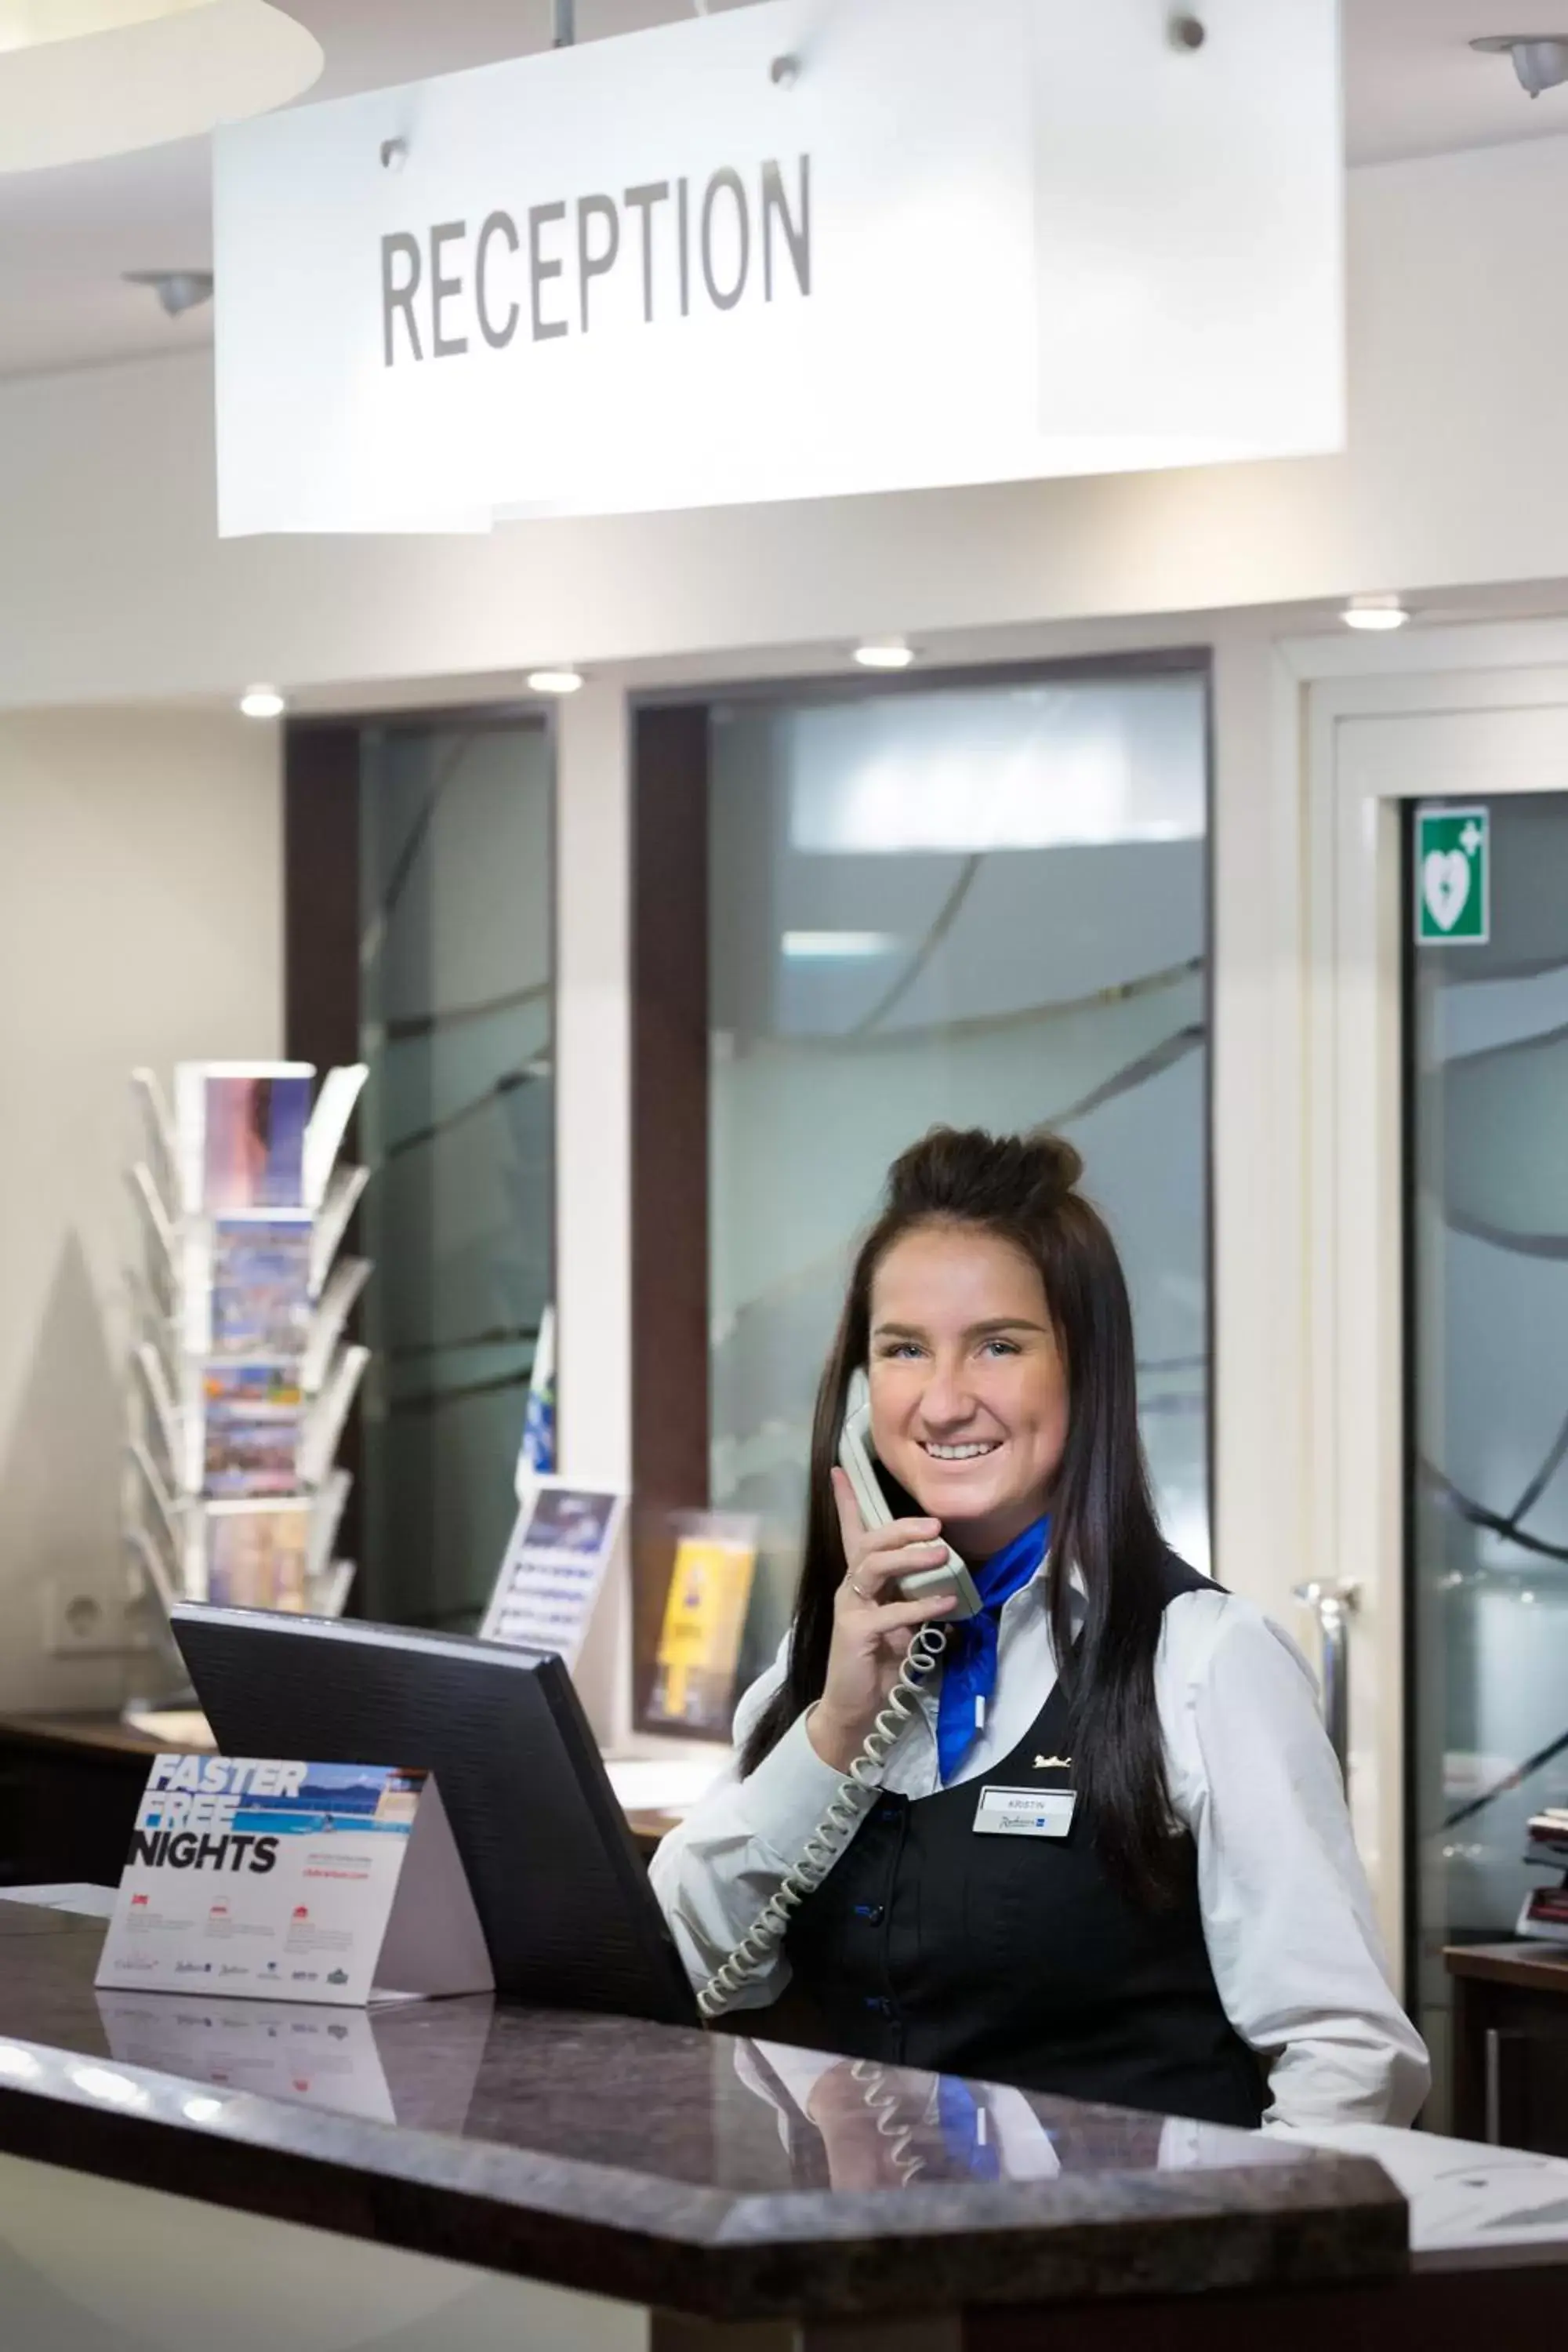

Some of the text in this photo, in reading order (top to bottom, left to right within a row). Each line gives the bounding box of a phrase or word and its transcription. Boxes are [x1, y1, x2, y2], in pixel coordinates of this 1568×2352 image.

[380, 154, 811, 367] RECEPTION
[147, 1754, 307, 1798] FASTER
[134, 1791, 241, 1831] FREE
[126, 1829, 280, 1875] NIGHTS
